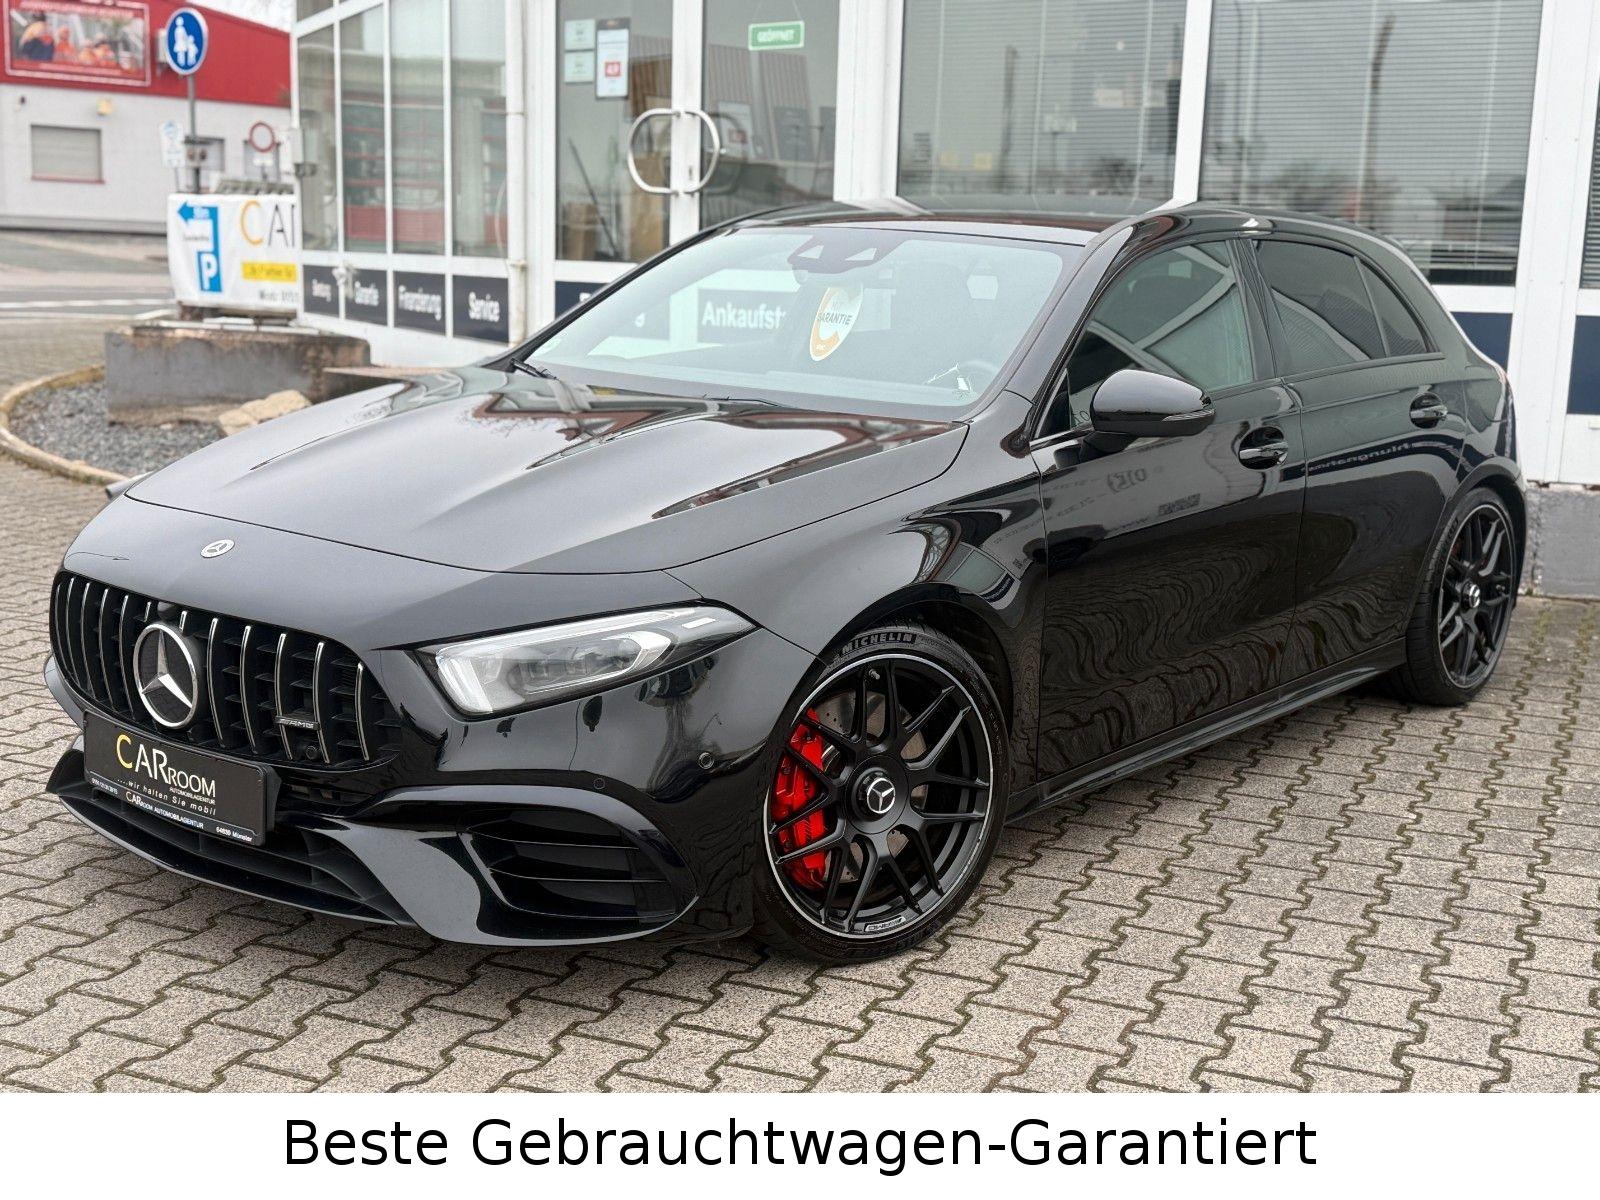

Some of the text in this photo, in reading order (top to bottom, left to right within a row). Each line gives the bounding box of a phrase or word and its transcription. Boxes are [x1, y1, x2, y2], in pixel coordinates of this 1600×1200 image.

[468, 291, 500, 322] Service
[841, 632, 913, 654] MICHELIN
[142, 785, 168, 800] halten
[172, 795, 187, 807] Sie
[190, 801, 216, 816] mobil
